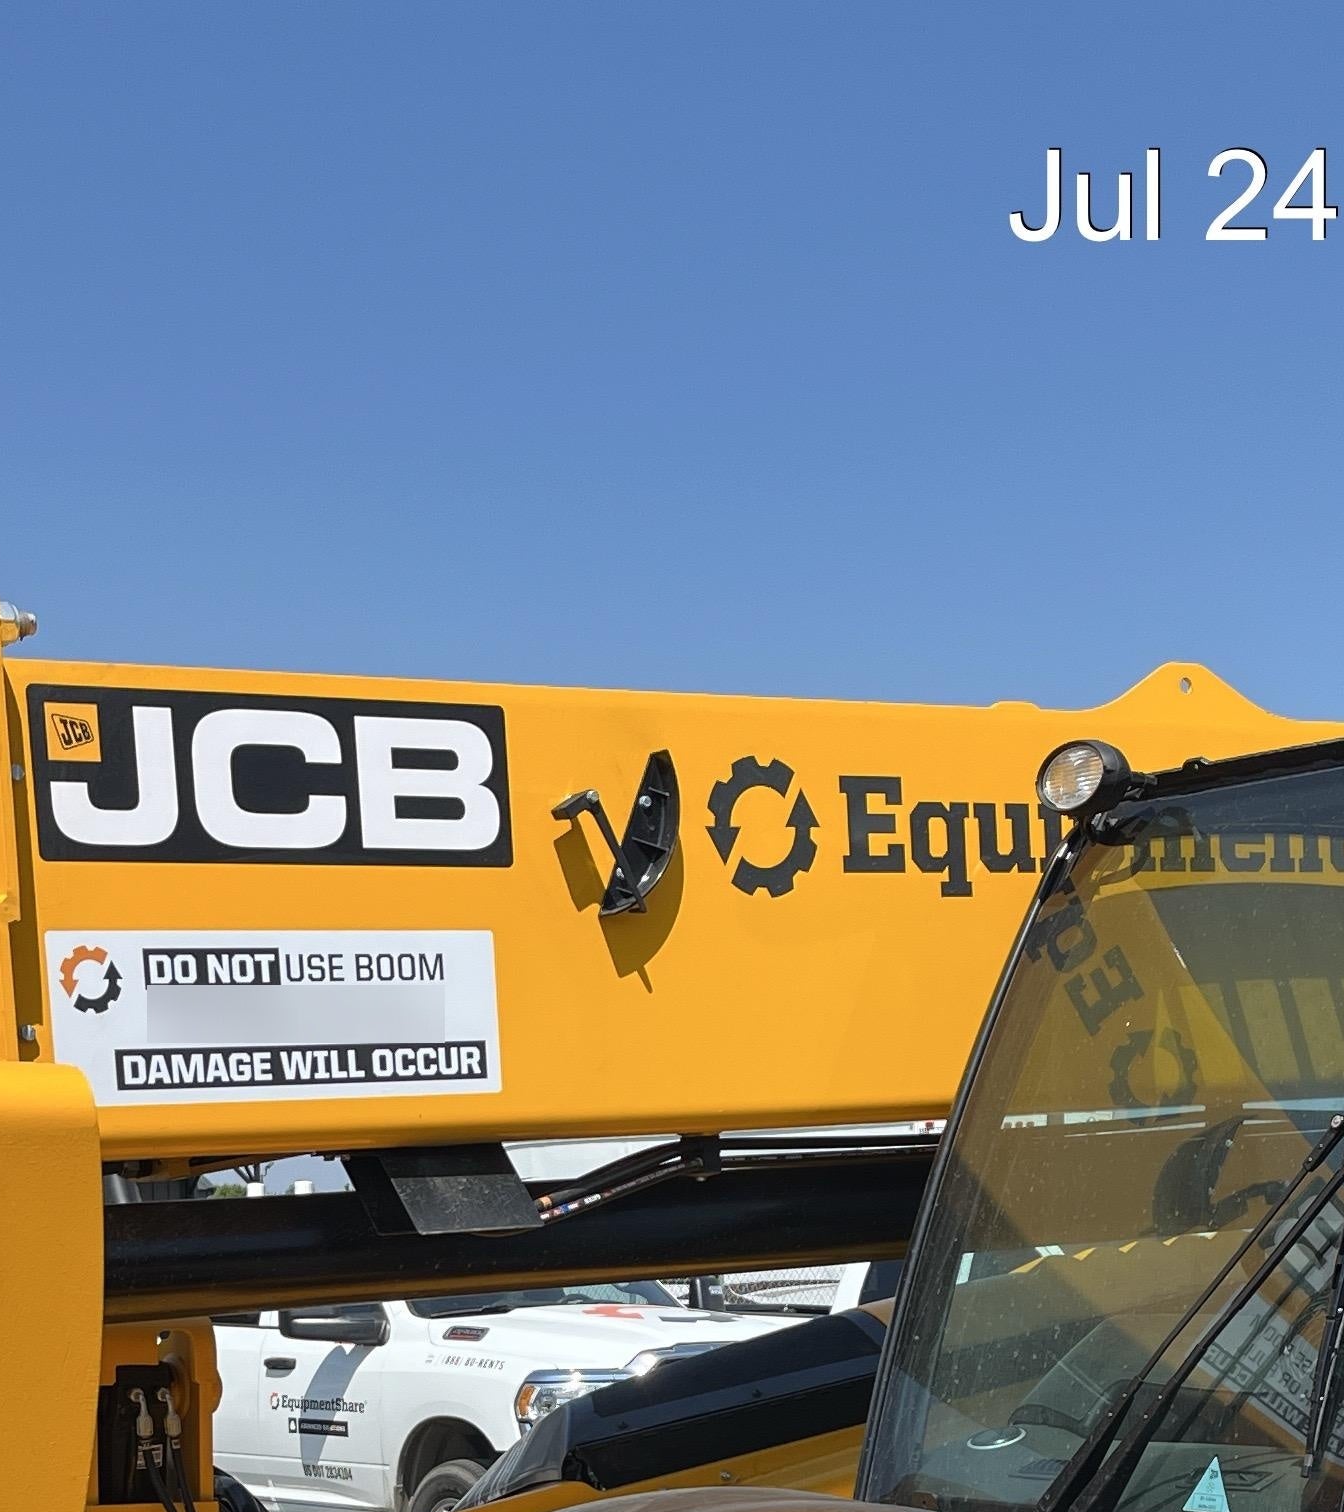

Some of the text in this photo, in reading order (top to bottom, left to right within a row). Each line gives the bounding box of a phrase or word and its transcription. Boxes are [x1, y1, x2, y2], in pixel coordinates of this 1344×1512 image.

[59, 717, 91, 746] JCB
[50, 705, 501, 850] JCB
[148, 952, 445, 985] DO NOT USE BOOM
[122, 1045, 482, 1087] DAMAGE WILL OCCUR
[281, 1394, 365, 1413] EquipmentShare
